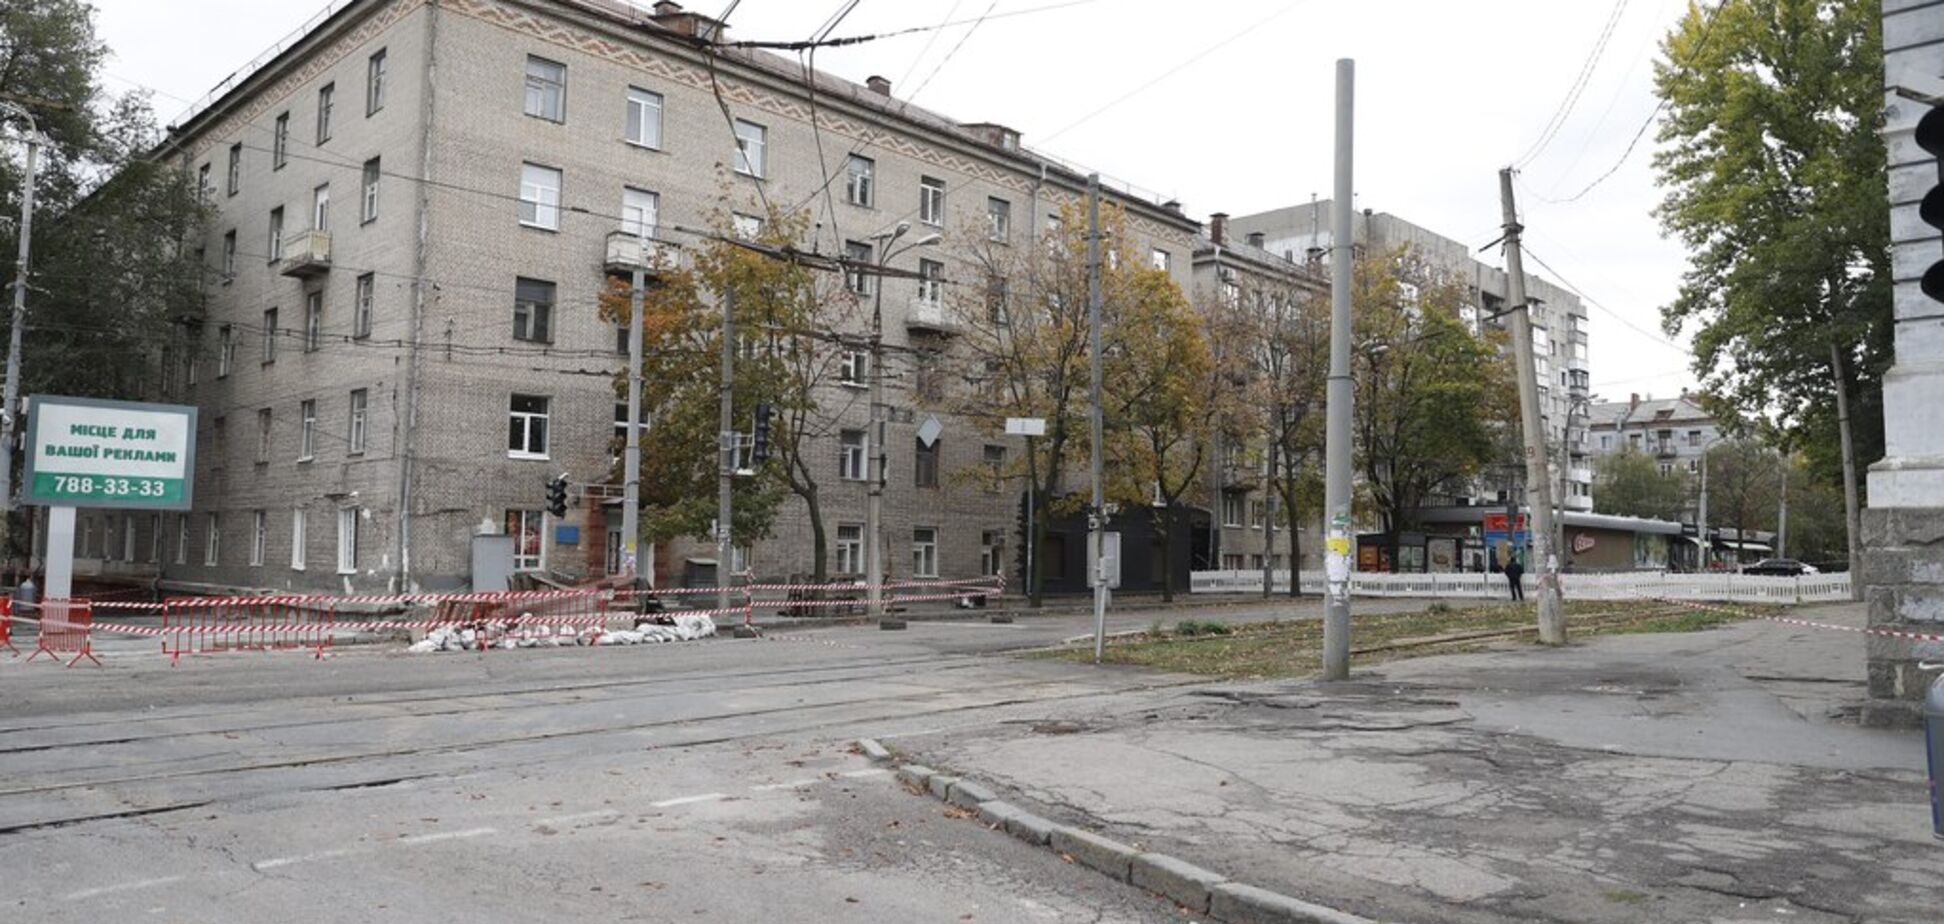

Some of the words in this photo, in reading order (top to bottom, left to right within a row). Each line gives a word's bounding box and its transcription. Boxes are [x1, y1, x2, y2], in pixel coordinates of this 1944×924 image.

[70, 424, 117, 438] МІСЦЕ
[122, 427, 157, 440] ДЛЯ
[45, 444, 99, 458] ВАШОЇ
[103, 447, 177, 463] РЕКЛАМИ
[54, 476, 165, 496] 788-33-33
